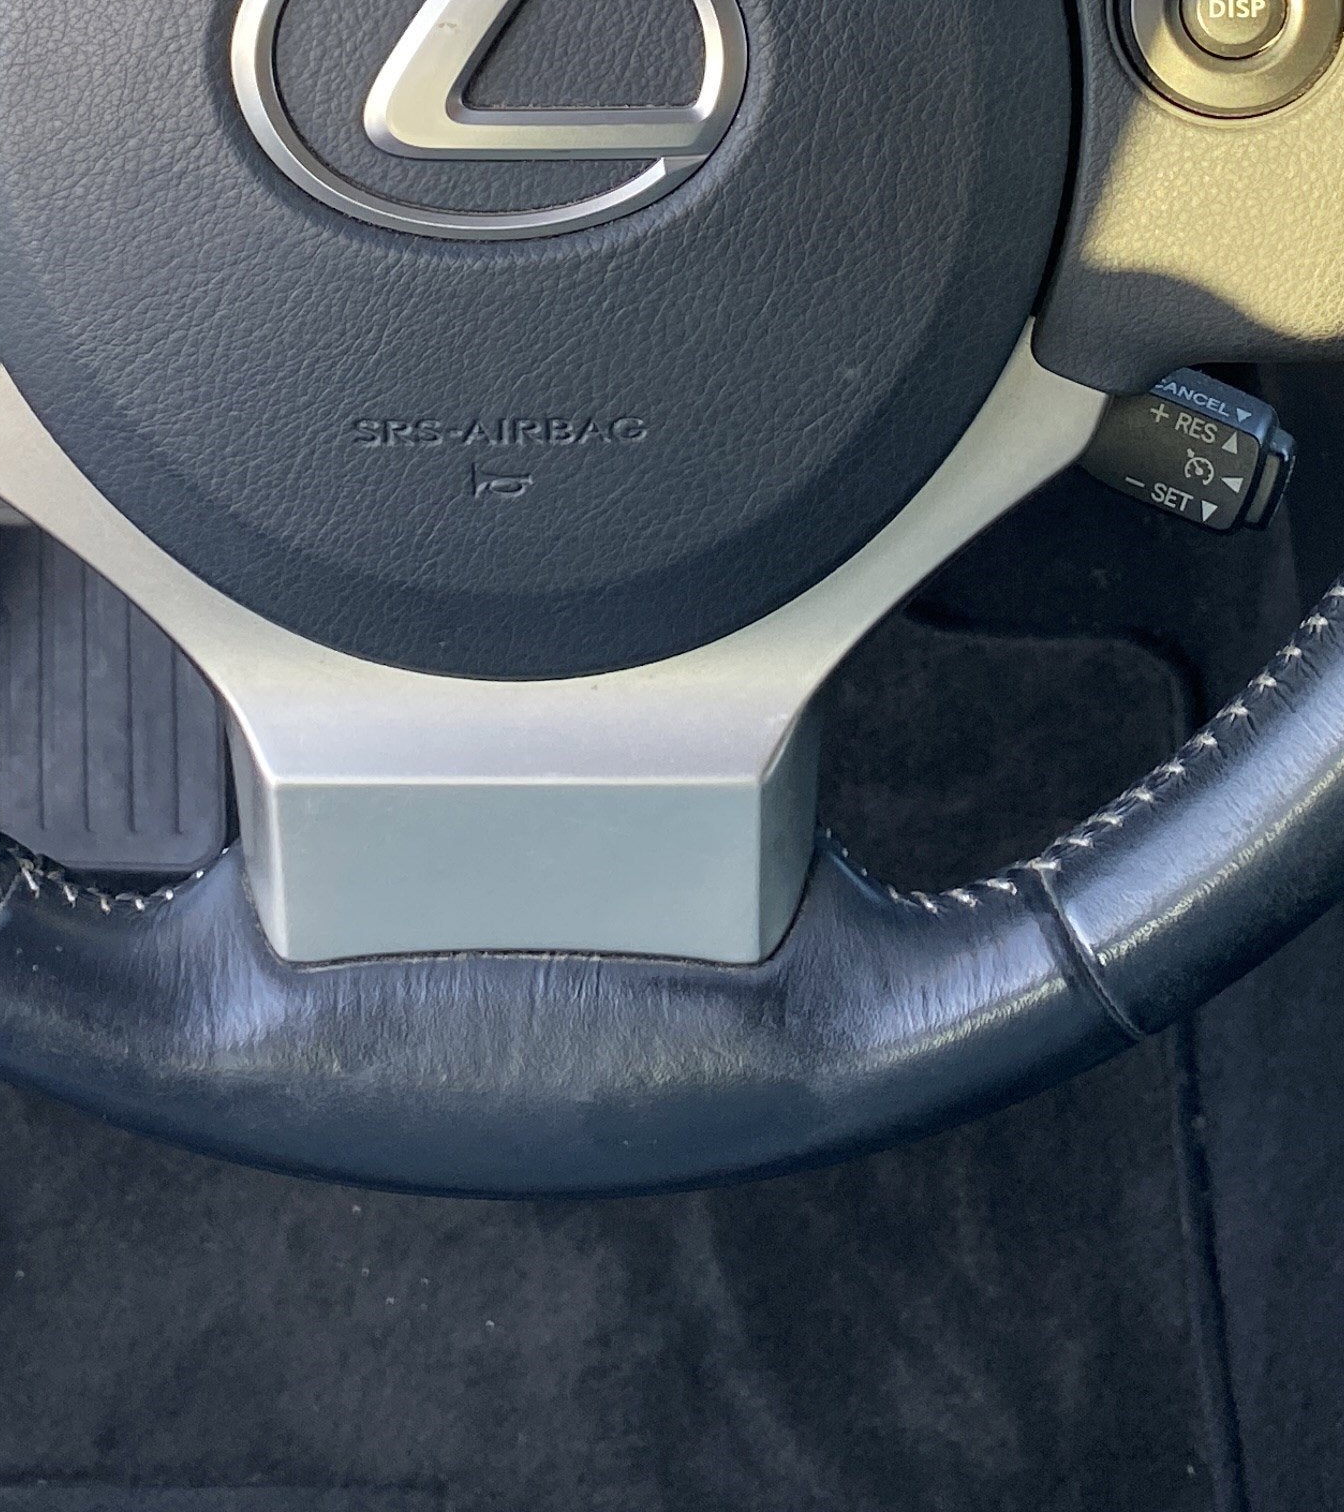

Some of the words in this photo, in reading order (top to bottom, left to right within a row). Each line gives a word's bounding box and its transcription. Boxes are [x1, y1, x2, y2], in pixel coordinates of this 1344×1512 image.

[1209, 0, 1266, 18] DISP
[353, 416, 648, 448] SRS-AIRBAG
[1175, 412, 1218, 444] RES
[1151, 483, 1194, 512] SET
